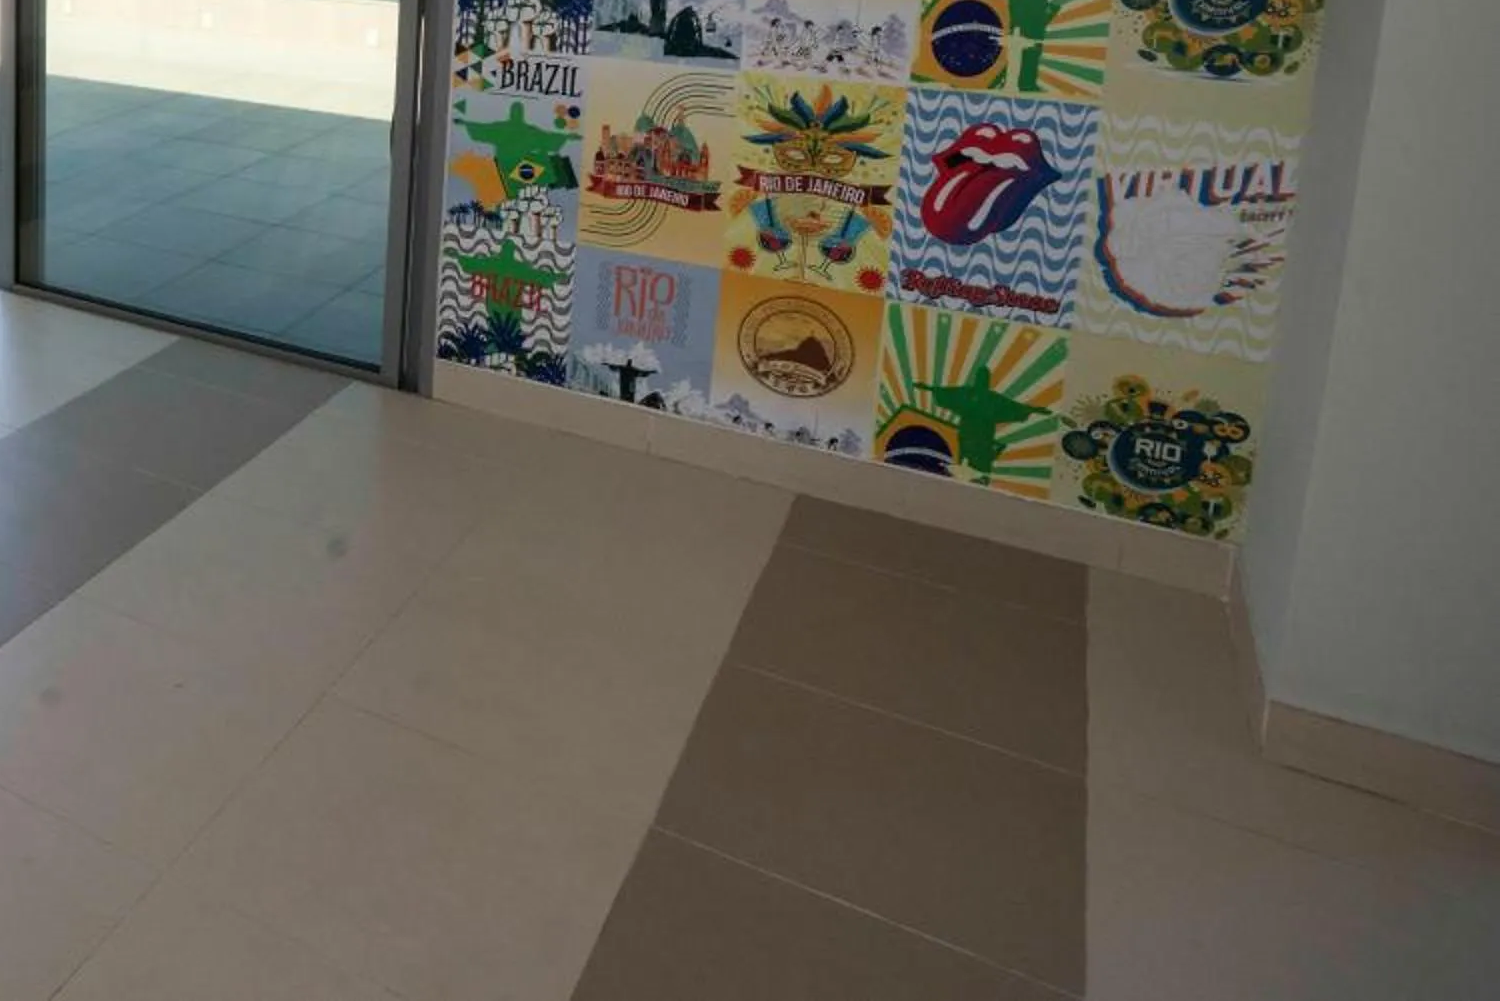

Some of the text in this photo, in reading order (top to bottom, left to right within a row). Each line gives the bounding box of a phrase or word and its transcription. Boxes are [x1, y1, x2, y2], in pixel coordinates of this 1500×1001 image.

[499, 57, 582, 98] BRAZIL
[759, 176, 866, 204] RIO DE JANEIRO
[1134, 437, 1183, 464] RIO
